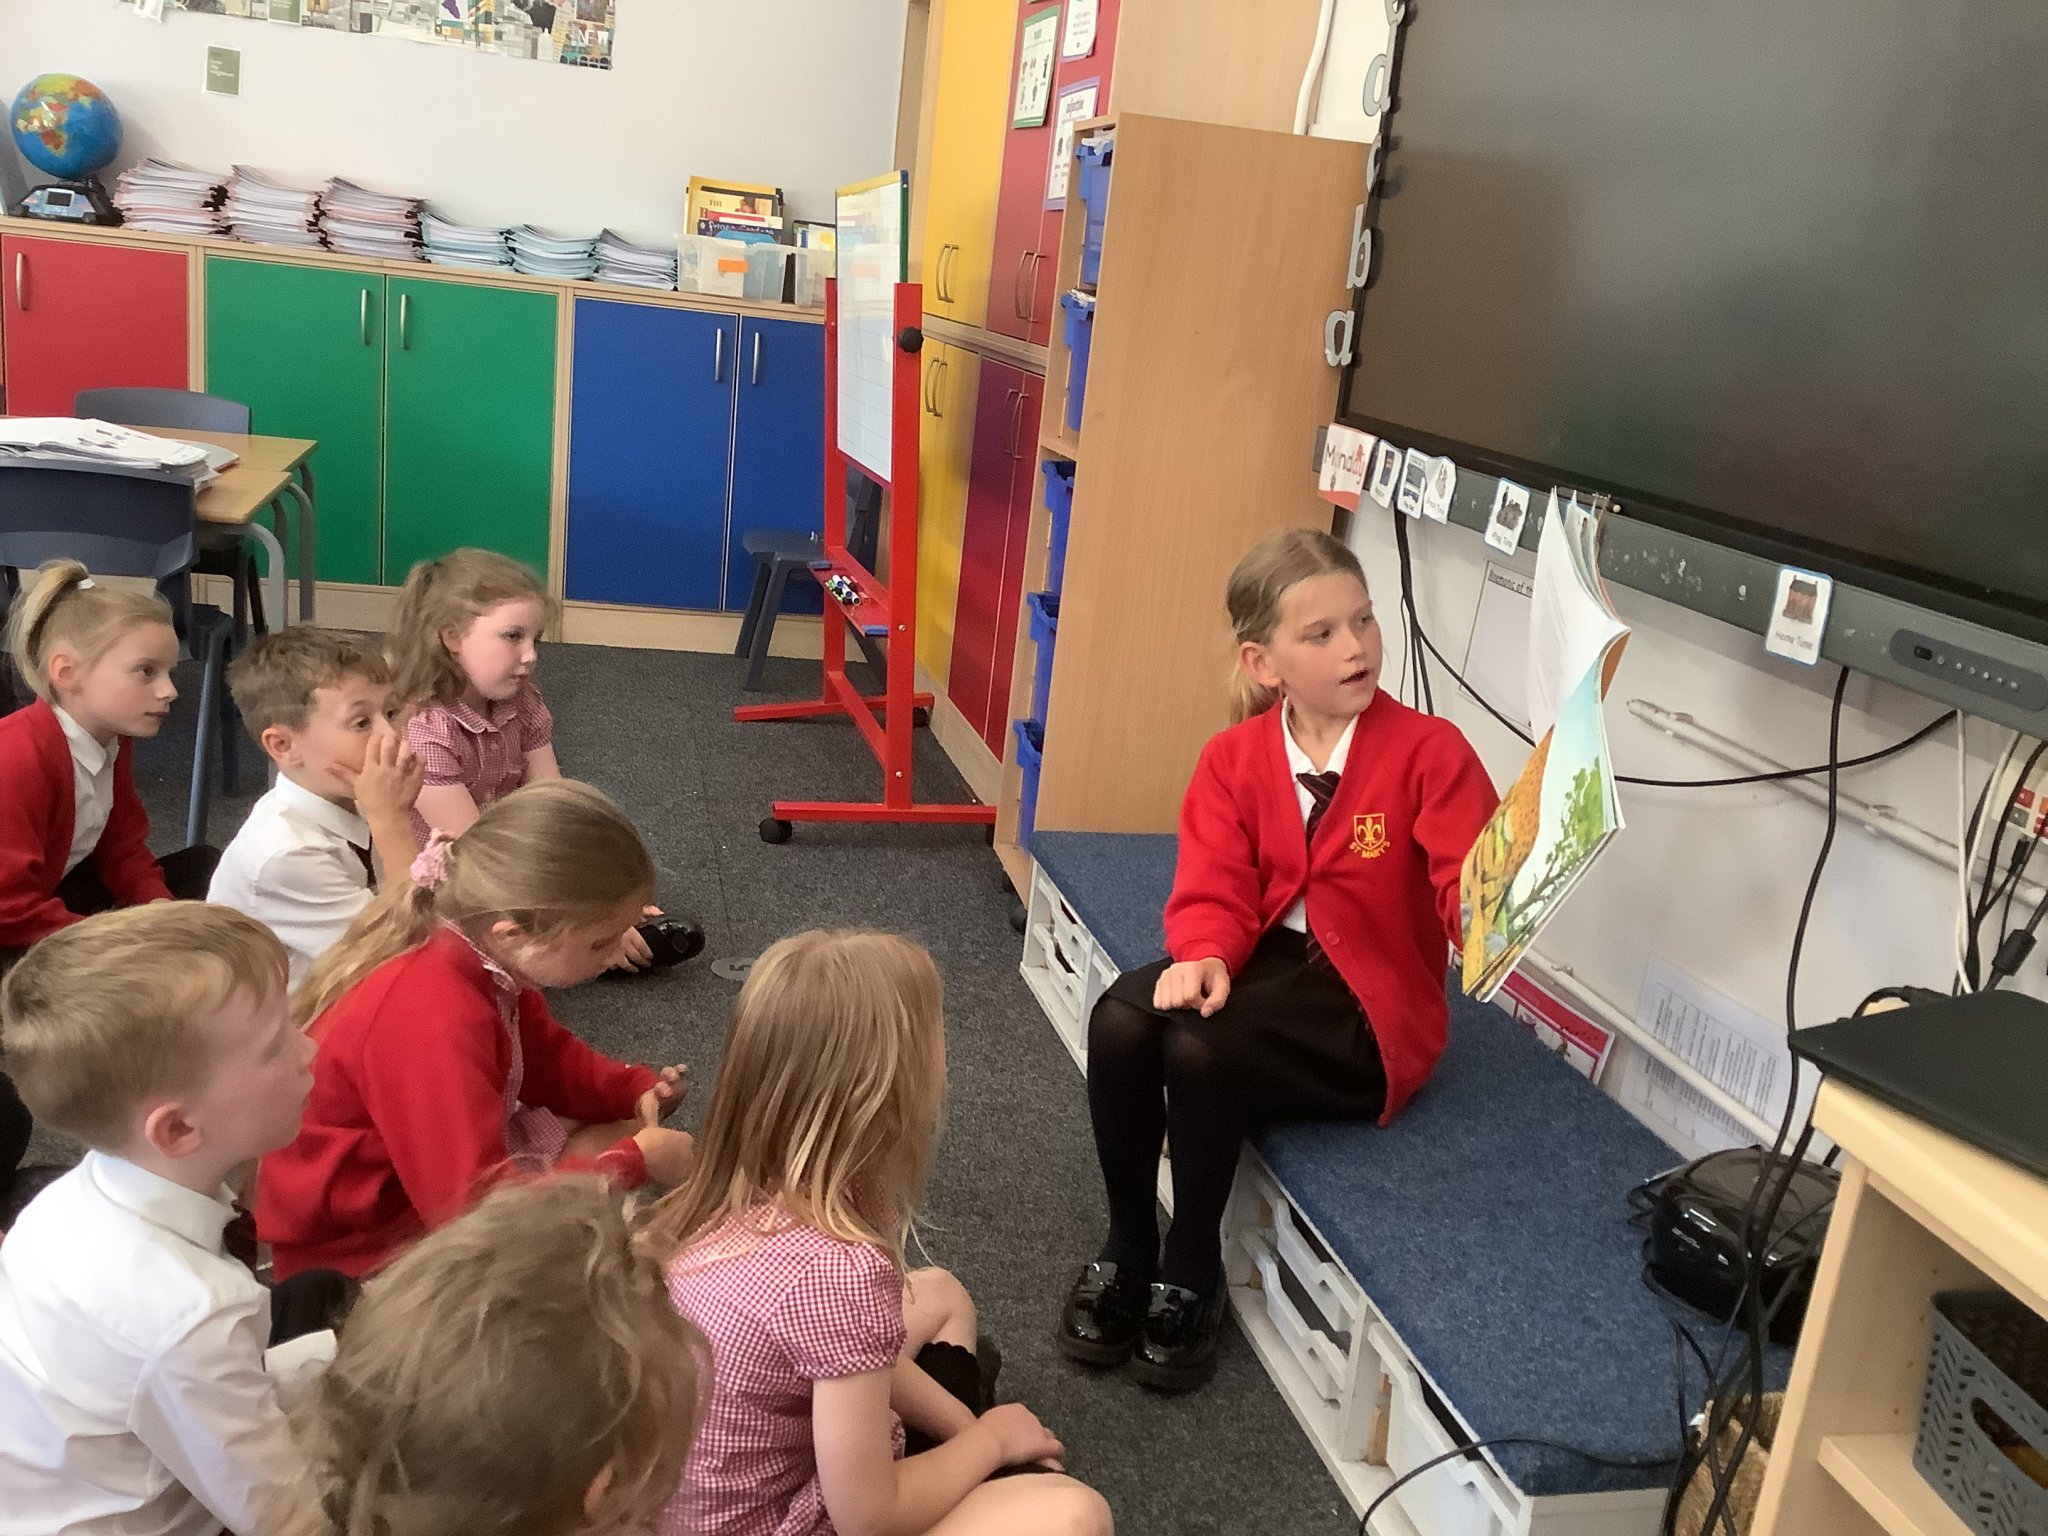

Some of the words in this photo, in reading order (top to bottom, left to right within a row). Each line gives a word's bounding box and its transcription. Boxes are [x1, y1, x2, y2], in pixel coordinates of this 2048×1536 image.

[1363, 22, 1397, 117] d
[1346, 203, 1372, 289] b
[1324, 309, 1355, 368] a
